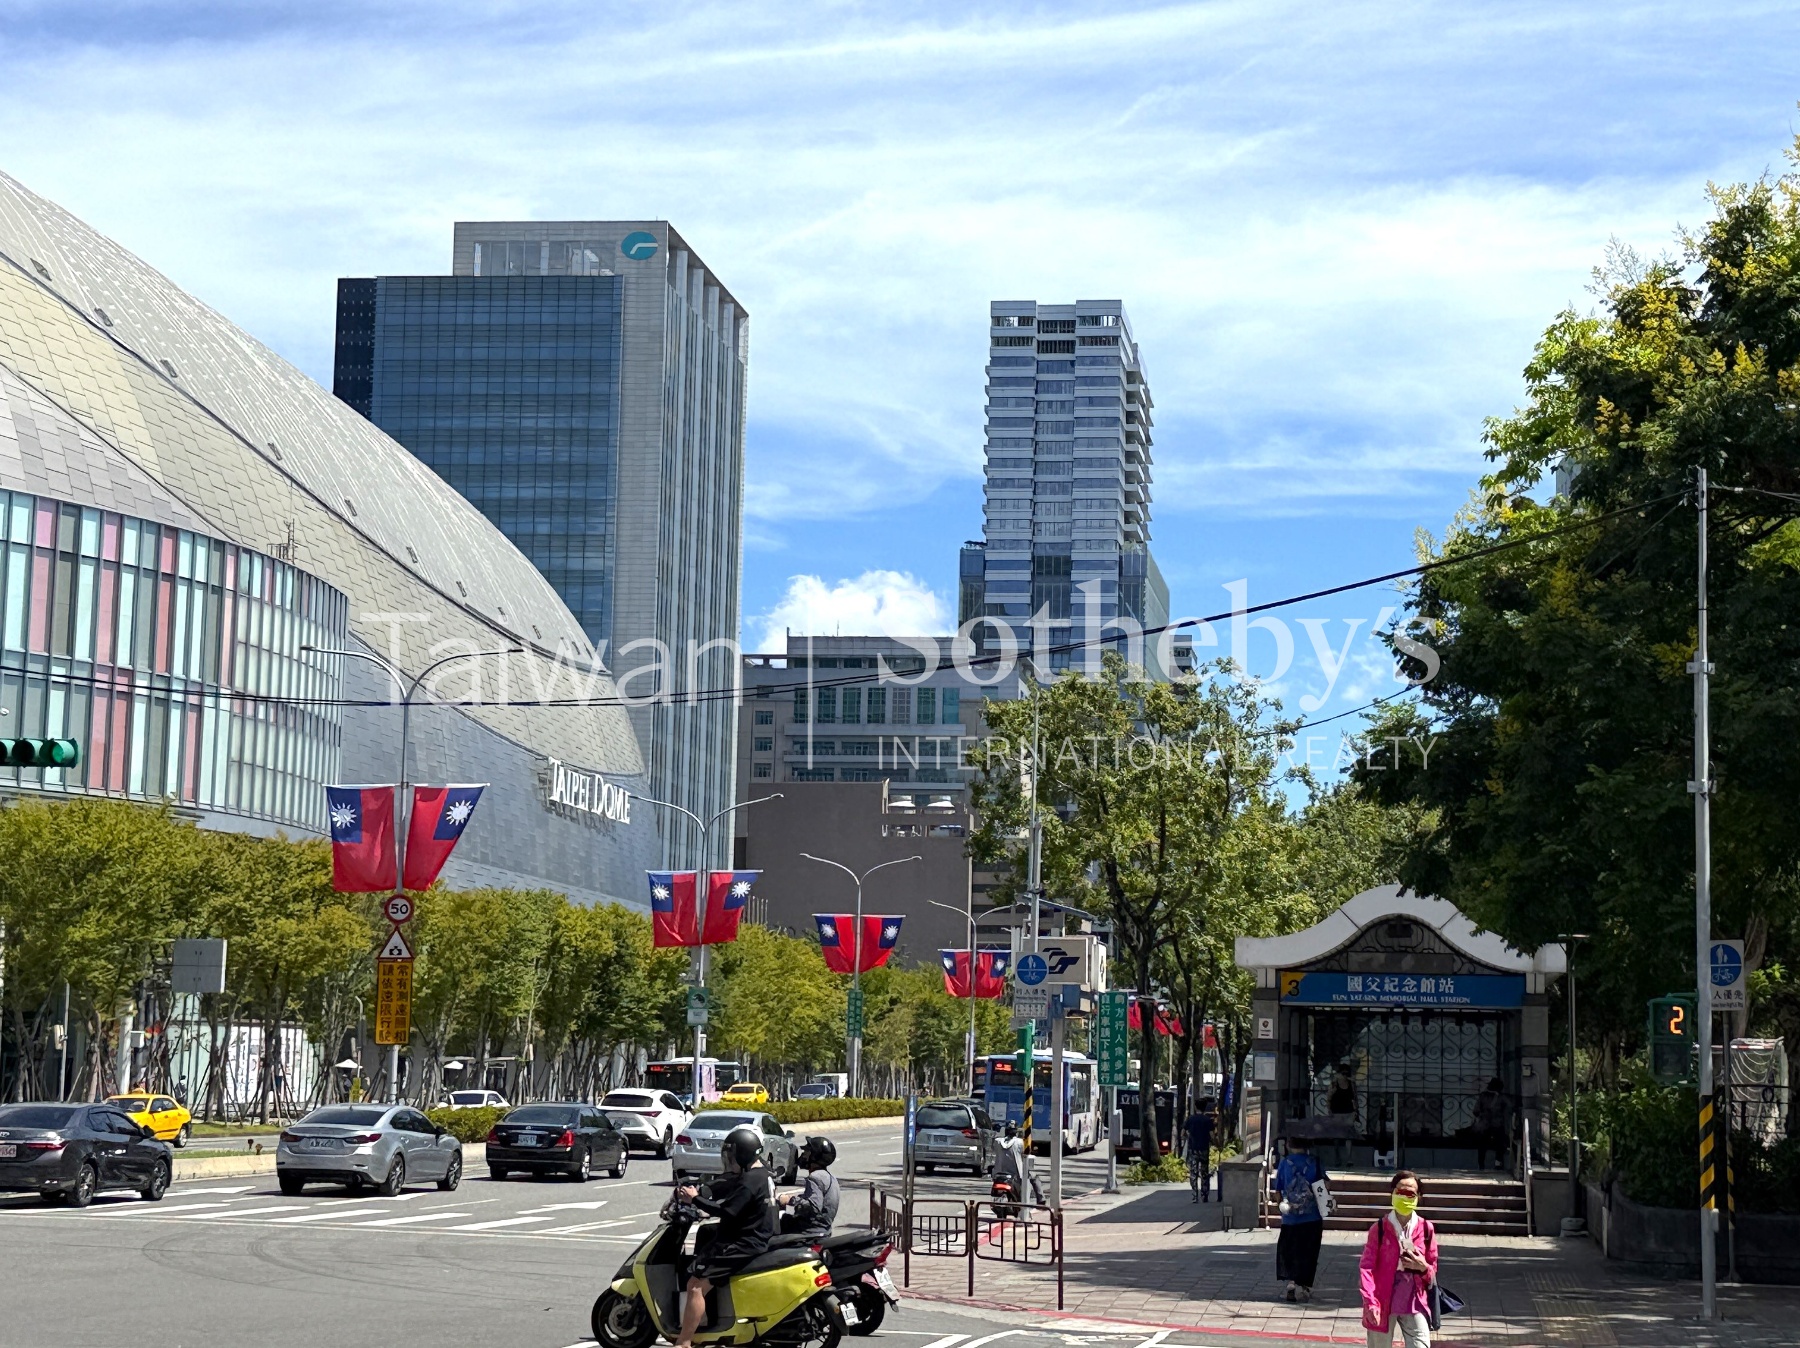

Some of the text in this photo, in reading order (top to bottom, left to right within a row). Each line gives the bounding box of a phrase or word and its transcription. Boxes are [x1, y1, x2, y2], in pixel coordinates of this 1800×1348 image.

[549, 756, 631, 825] TAIPEI DOME
[390, 903, 409, 915] 50
[1288, 979, 1300, 997] 3
[1347, 975, 1454, 993] 國父紀念館站
[1713, 989, 1744, 1001] 人優先
[1669, 1005, 1684, 1035] 2
